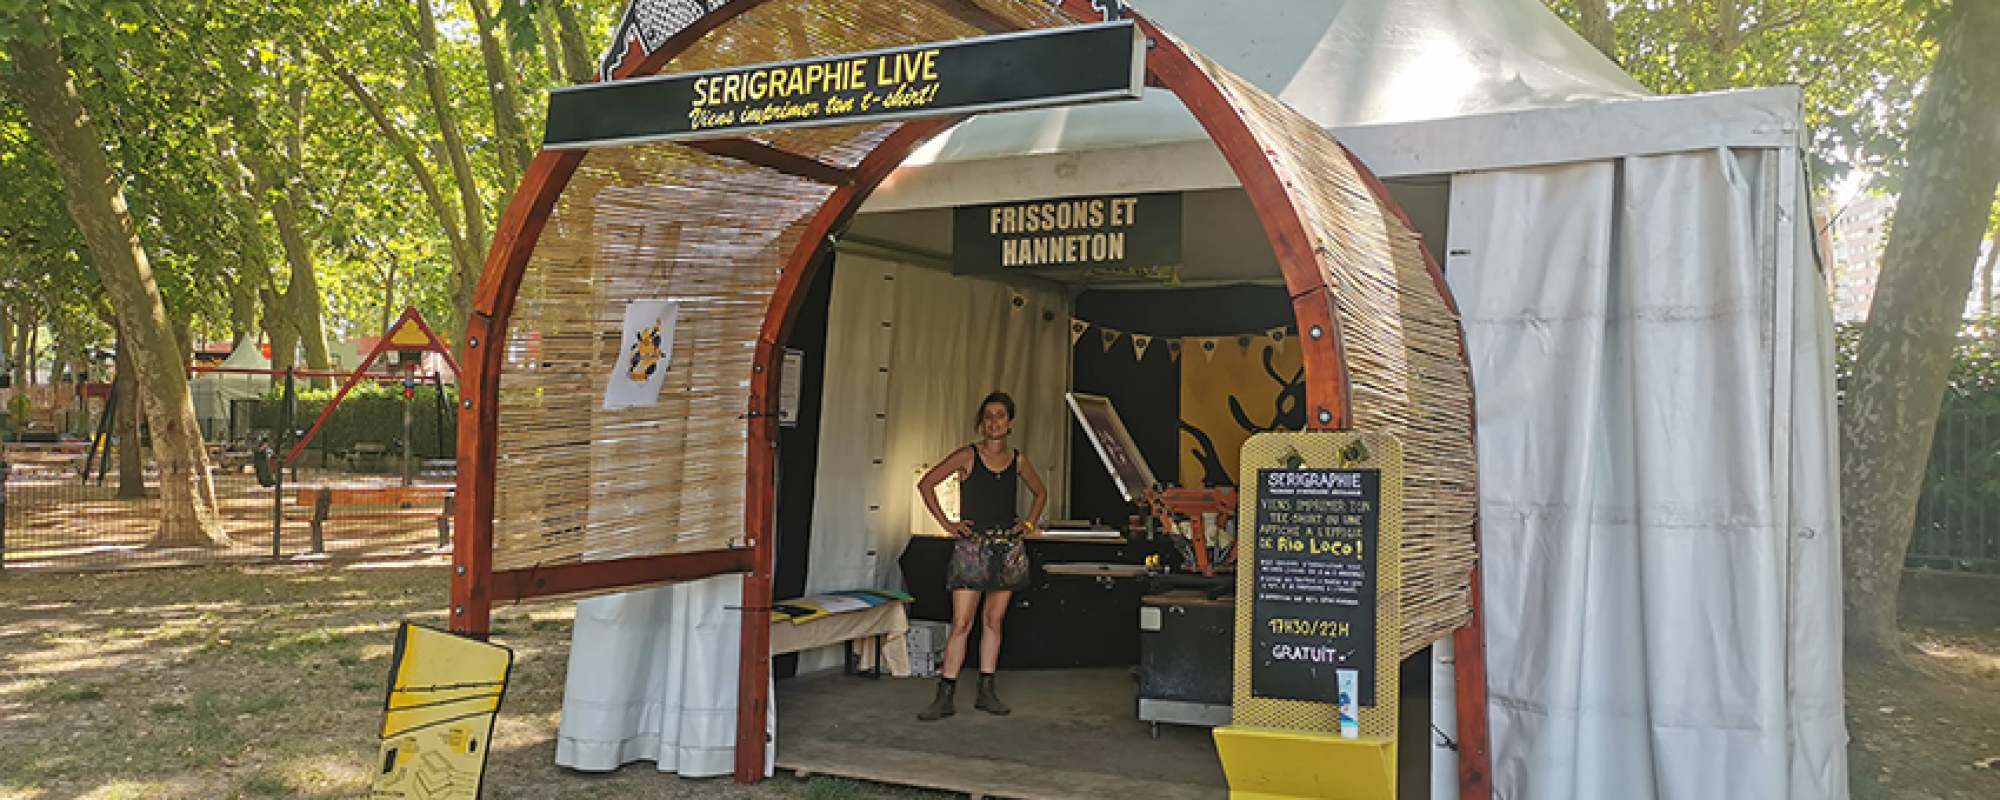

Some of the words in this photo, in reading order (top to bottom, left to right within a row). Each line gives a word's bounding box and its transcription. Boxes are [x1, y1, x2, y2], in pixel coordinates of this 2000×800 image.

[692, 57, 868, 107] SERIGRAPHIE
[877, 49, 940, 86] LIVE
[990, 199, 1105, 235] FRISSONS
[1110, 197, 1140, 227] ET
[1001, 231, 1125, 267] HANNETON
[1267, 472, 1361, 488] SERIGRAPHIE
[1277, 536, 1304, 552] Rio
